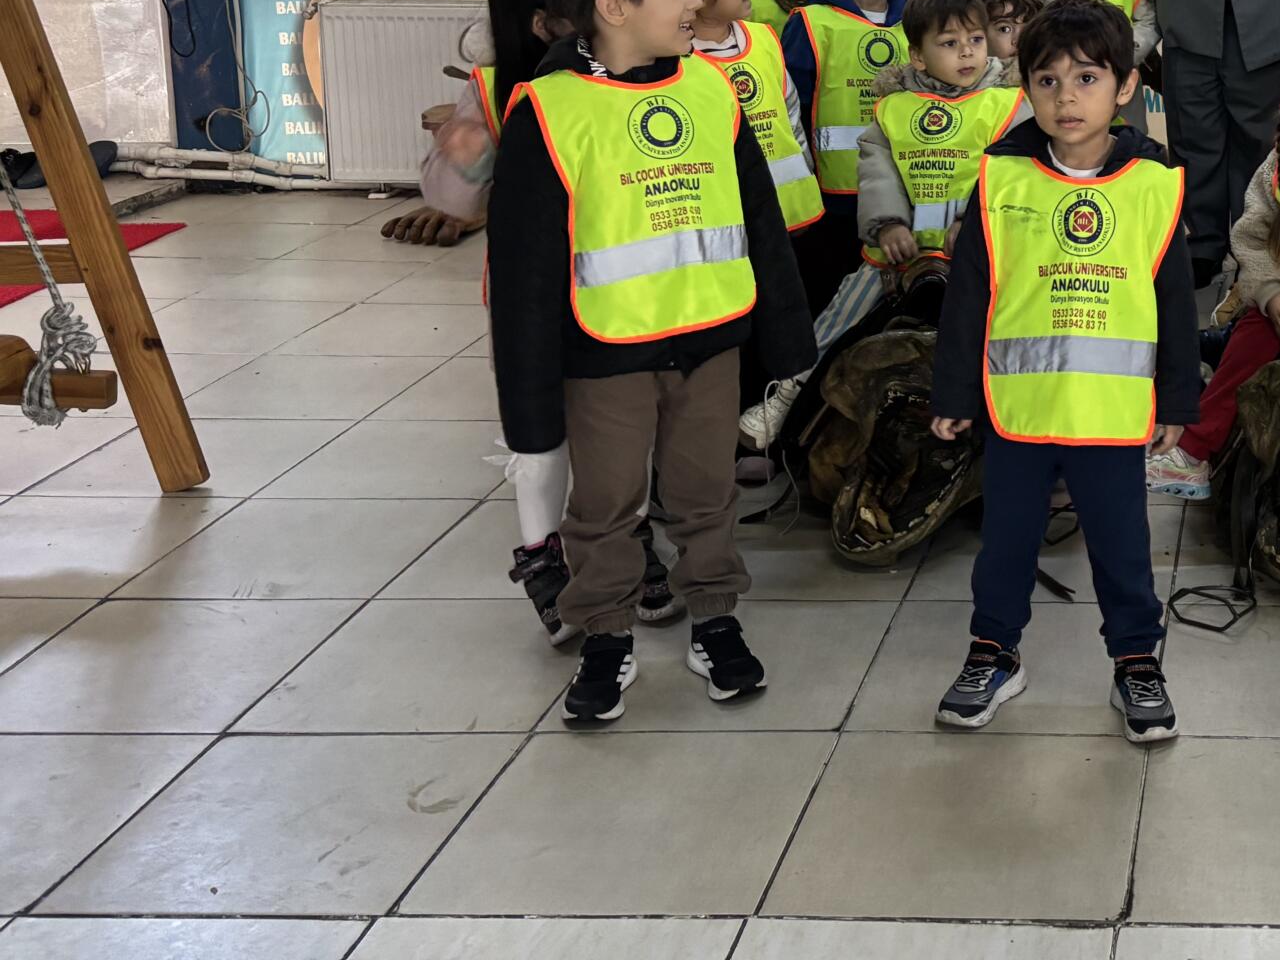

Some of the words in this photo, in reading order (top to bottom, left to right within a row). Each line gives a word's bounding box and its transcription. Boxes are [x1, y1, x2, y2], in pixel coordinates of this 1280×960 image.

[909, 161, 955, 171] ANAOKULU
[635, 166, 666, 185] ÇOCUK
[650, 209, 671, 221] 0533
[672, 207, 688, 217] 328
[652, 219, 673, 232] 0536
[674, 216, 690, 226] 942
[1051, 278, 1110, 294] ANAOKULU
[1052, 308, 1069, 319] 0533
[1069, 308, 1084, 318] 328
[1086, 309, 1096, 319] 42
[1097, 310, 1107, 320] 60
[1052, 319, 1068, 330] 0536
[1069, 319, 1084, 329] 942
[1085, 320, 1096, 330] 83
[1097, 321, 1107, 331] 71
